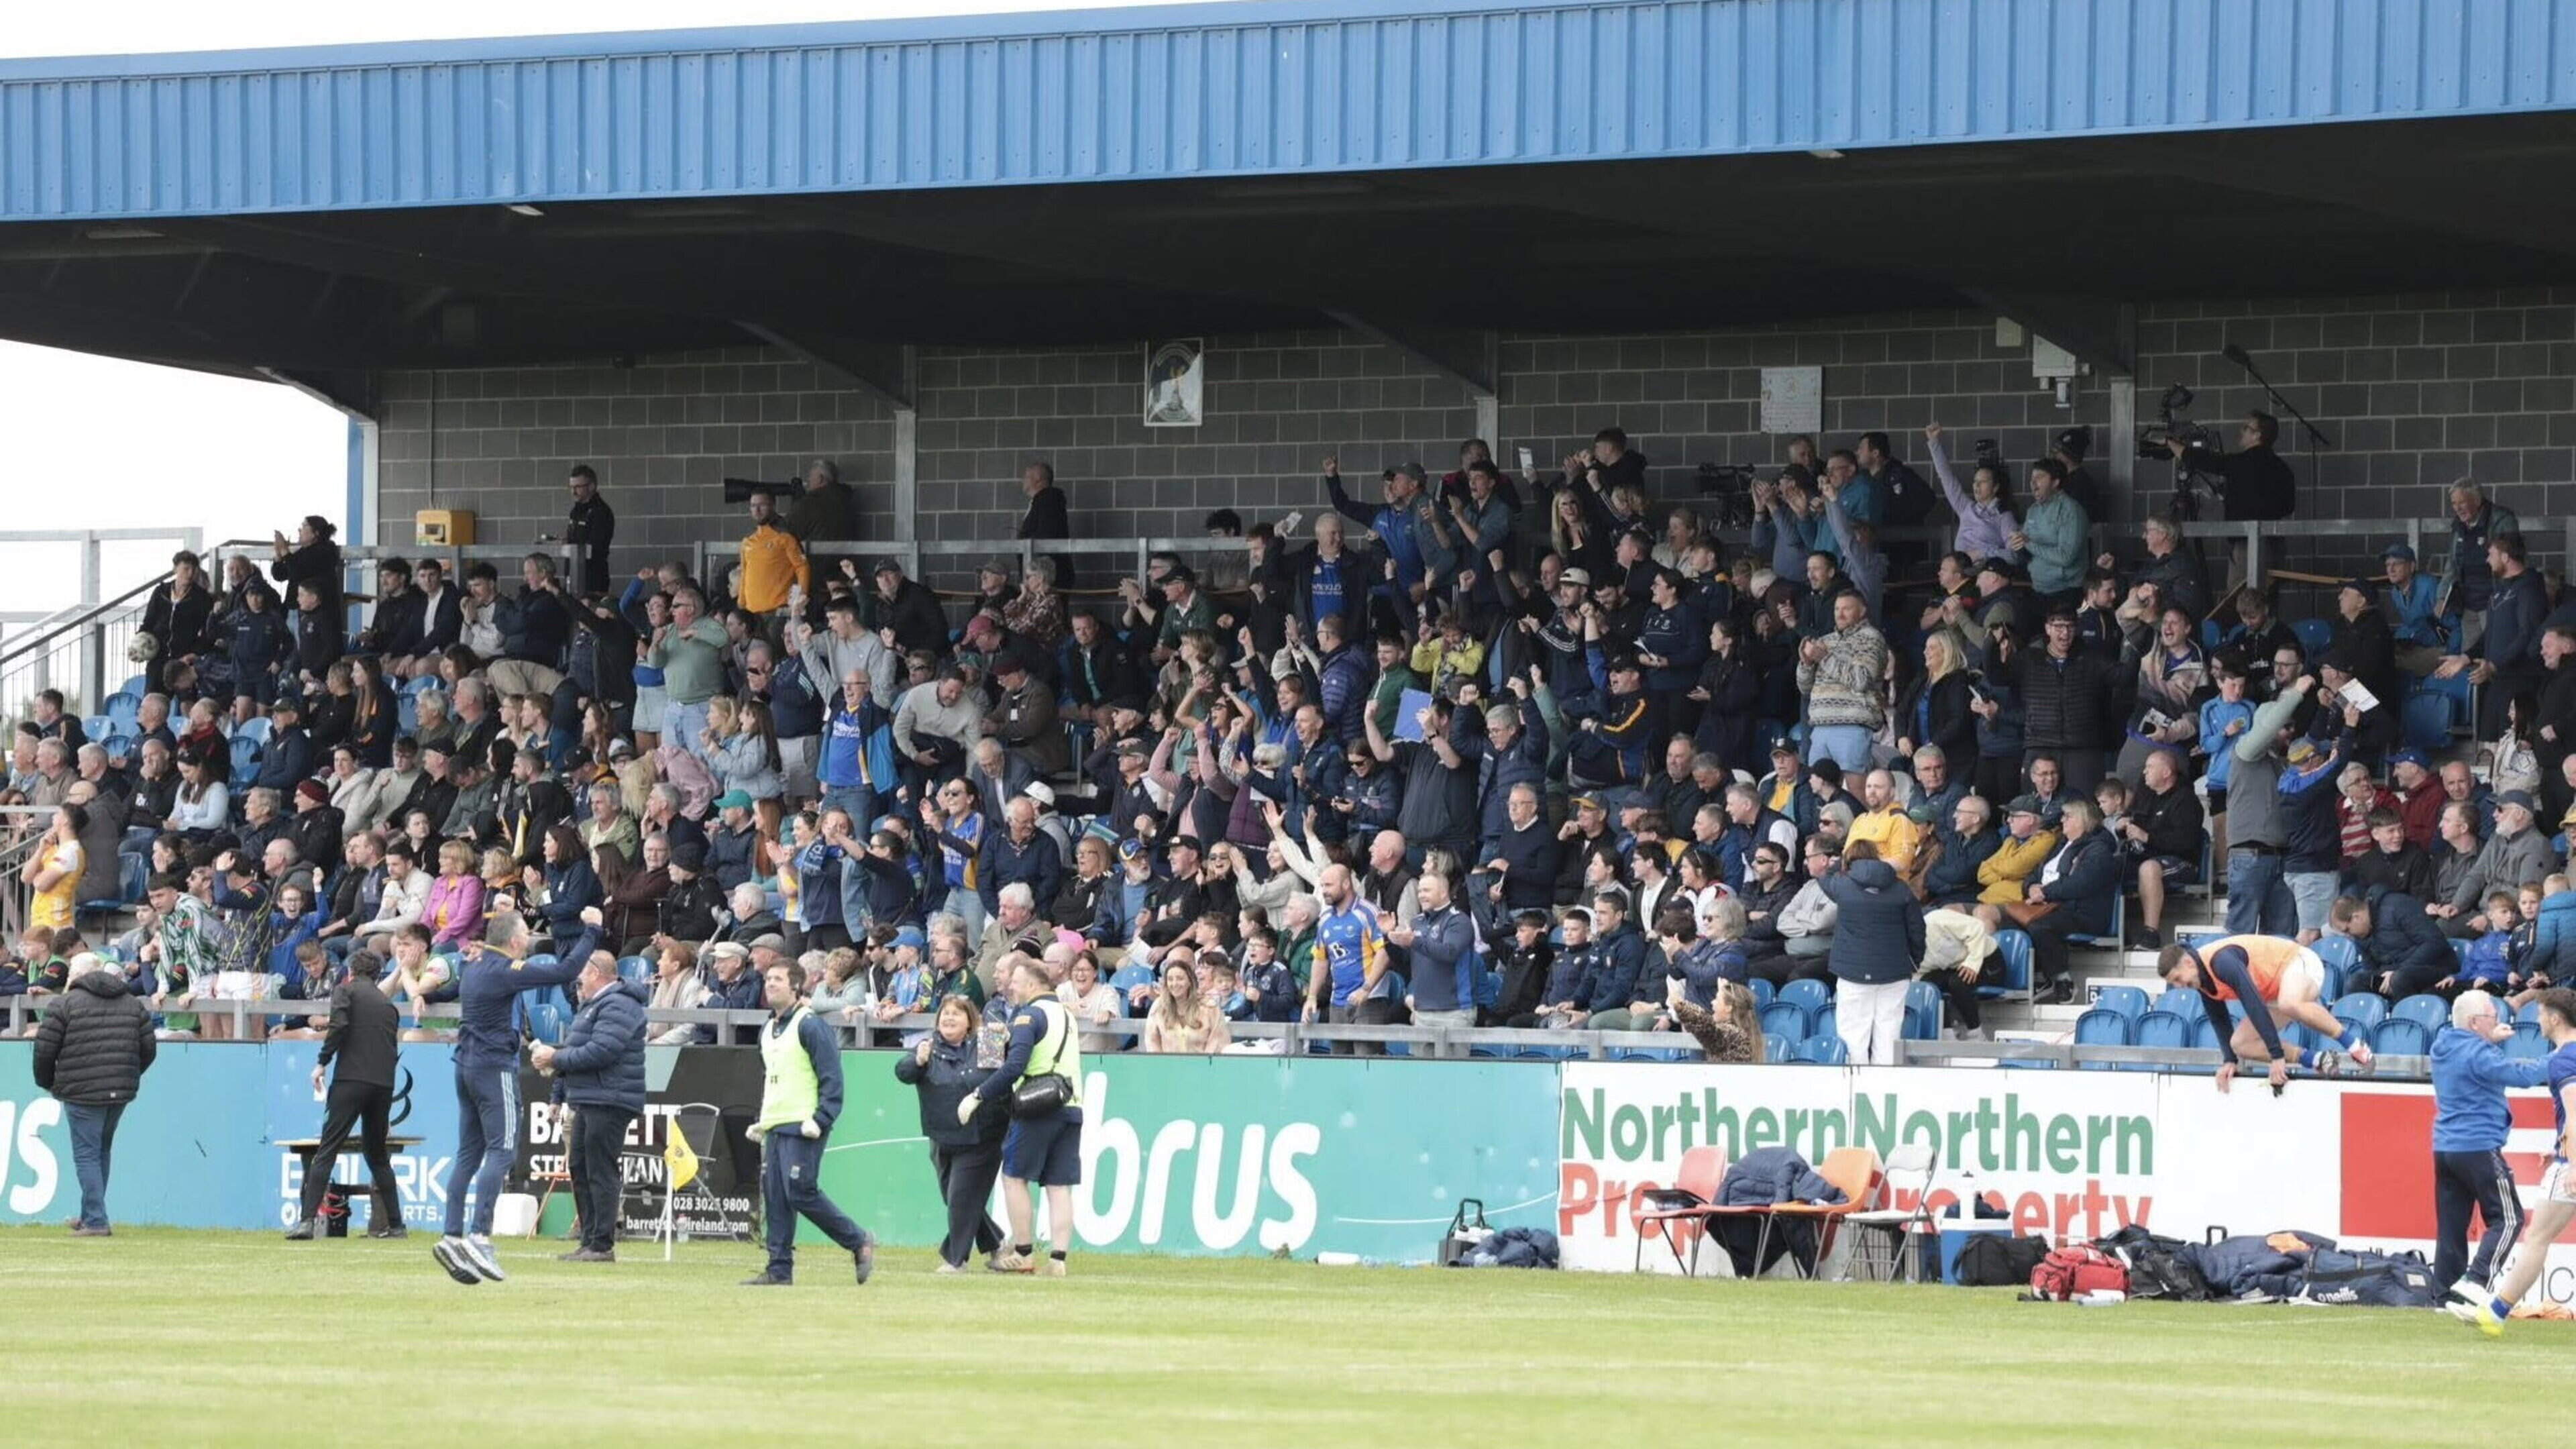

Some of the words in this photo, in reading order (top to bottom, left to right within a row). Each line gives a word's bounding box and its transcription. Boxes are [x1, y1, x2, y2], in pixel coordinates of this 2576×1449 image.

[1561, 1087, 1847, 1166] Northern
[1854, 1092, 2153, 1175] Northern
[674, 1197, 693, 1210] 028
[723, 1198, 750, 1212] 9800
